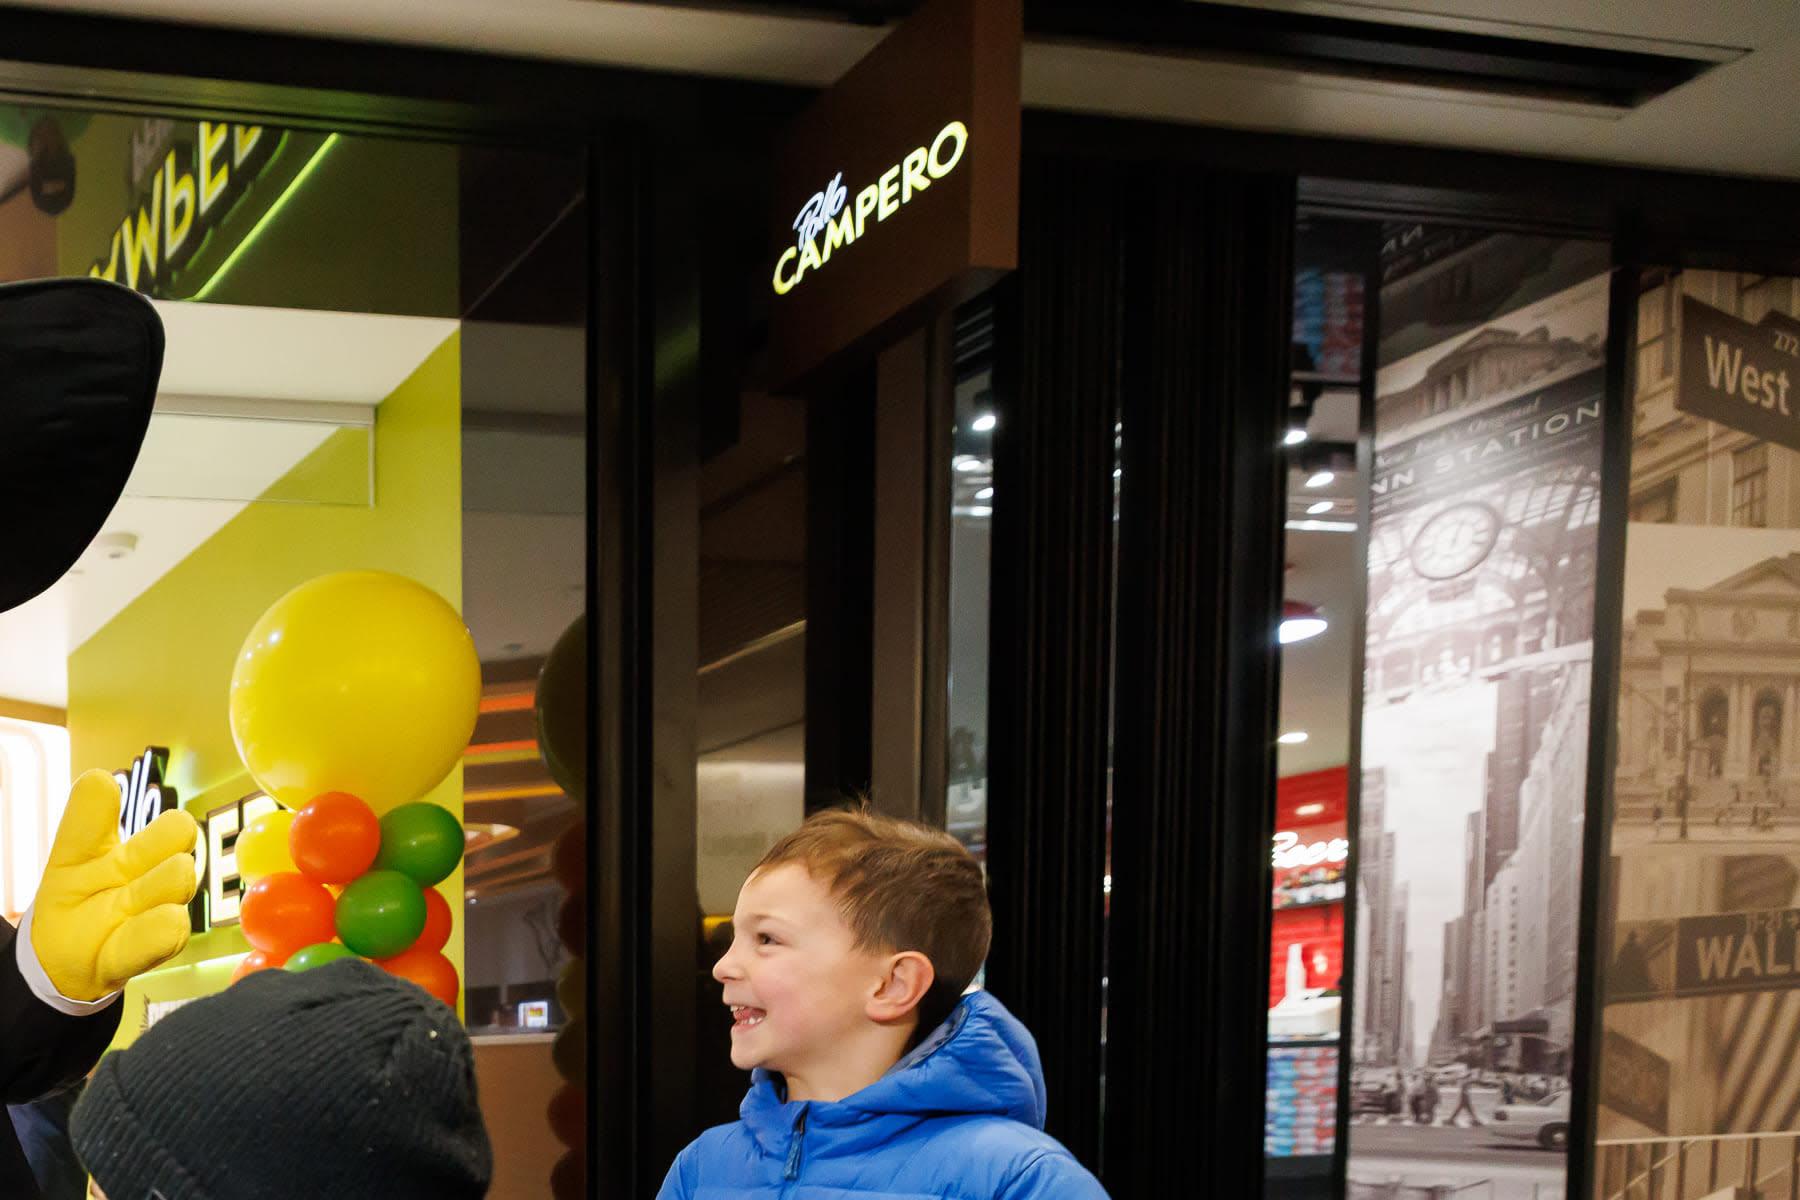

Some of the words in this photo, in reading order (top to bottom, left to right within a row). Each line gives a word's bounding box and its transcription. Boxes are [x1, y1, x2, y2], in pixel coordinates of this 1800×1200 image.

[772, 120, 968, 295] CAMPERO
[792, 171, 848, 251] Pollo
[1704, 335, 1790, 417] West
[1435, 402, 1600, 474] STATION
[1697, 930, 1800, 982] WAL
